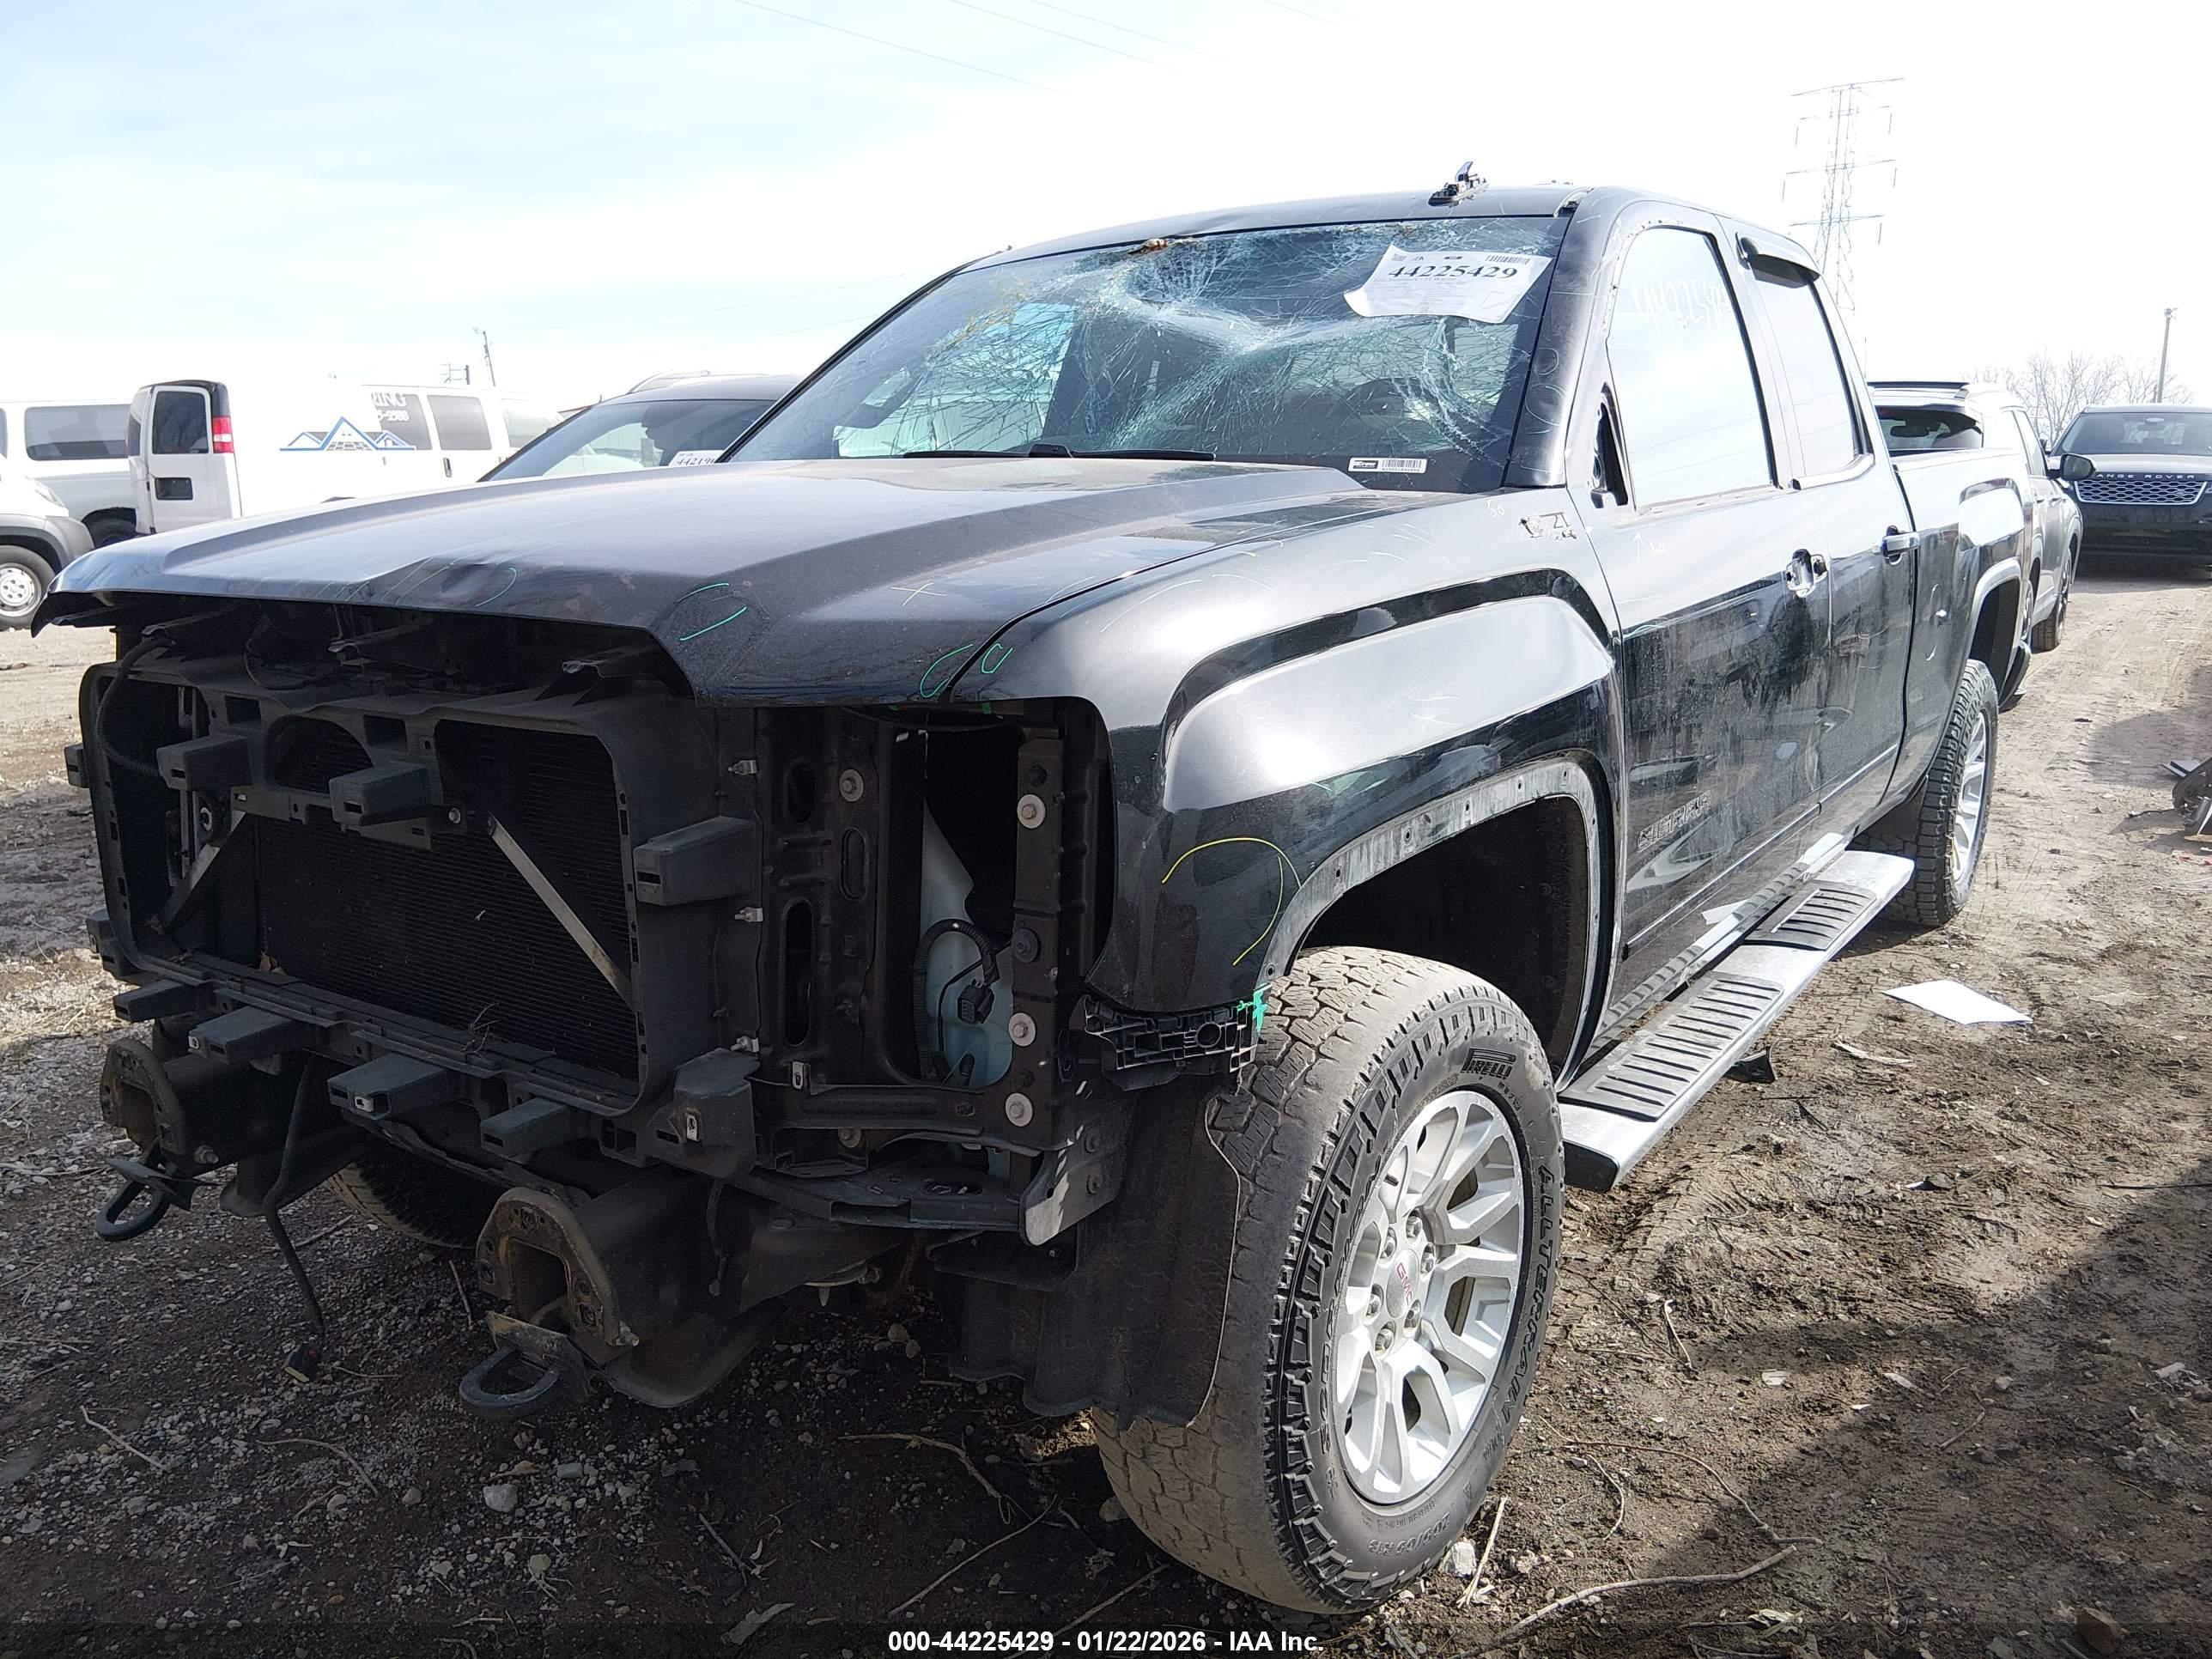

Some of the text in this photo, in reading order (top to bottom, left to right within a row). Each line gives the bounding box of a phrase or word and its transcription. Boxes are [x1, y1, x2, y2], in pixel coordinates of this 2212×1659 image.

[1388, 265, 1518, 278] 44225429
[1461, 1048, 1516, 1079] PIRELLI
[1396, 1262, 1413, 1306] GMC
